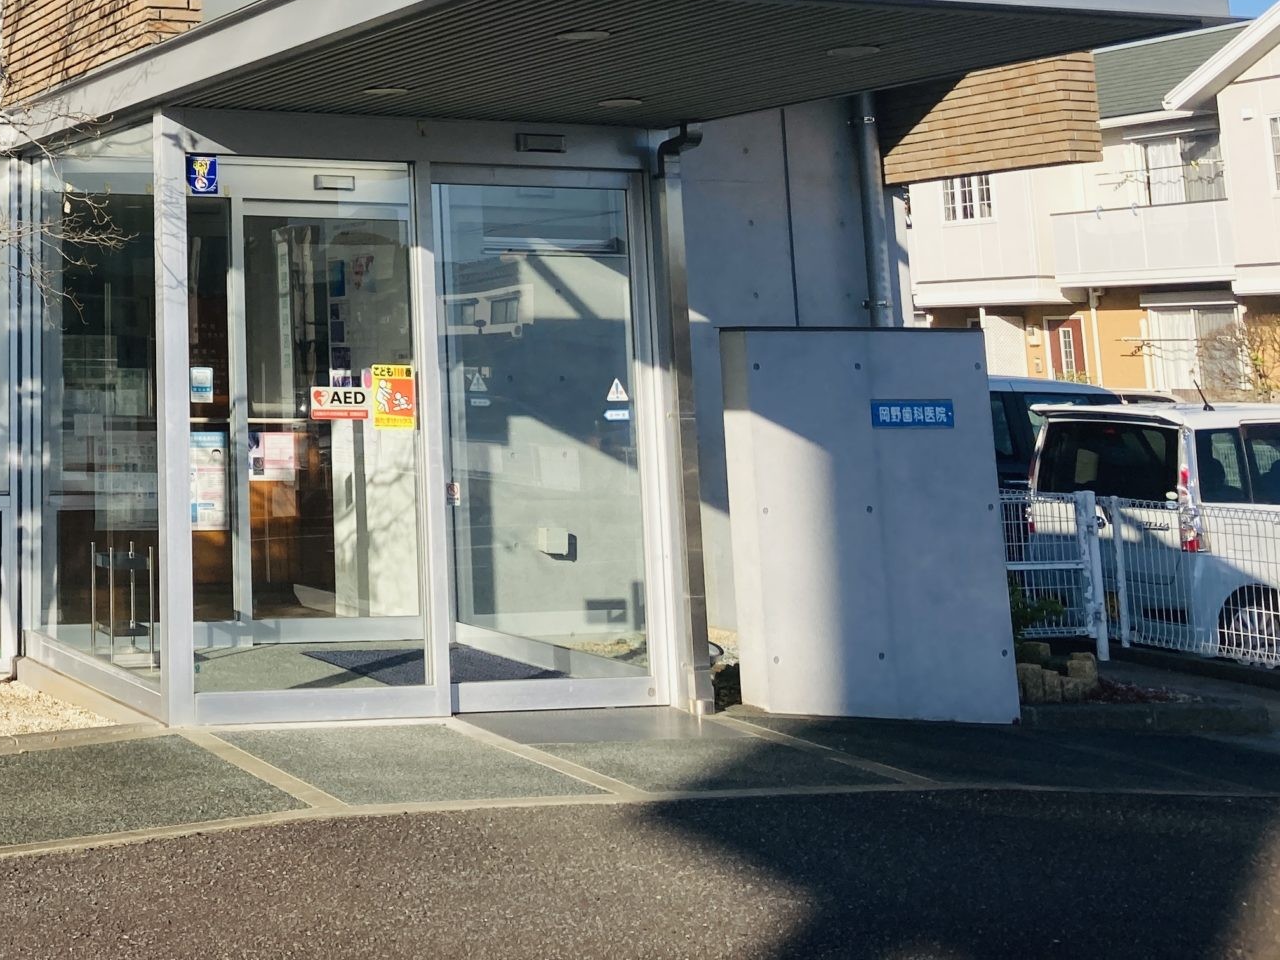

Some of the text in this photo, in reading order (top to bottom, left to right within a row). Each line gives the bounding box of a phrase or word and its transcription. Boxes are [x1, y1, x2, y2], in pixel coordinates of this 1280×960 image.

[330, 391, 366, 405] AED
[879, 406, 947, 422] 岡野歯科医院
